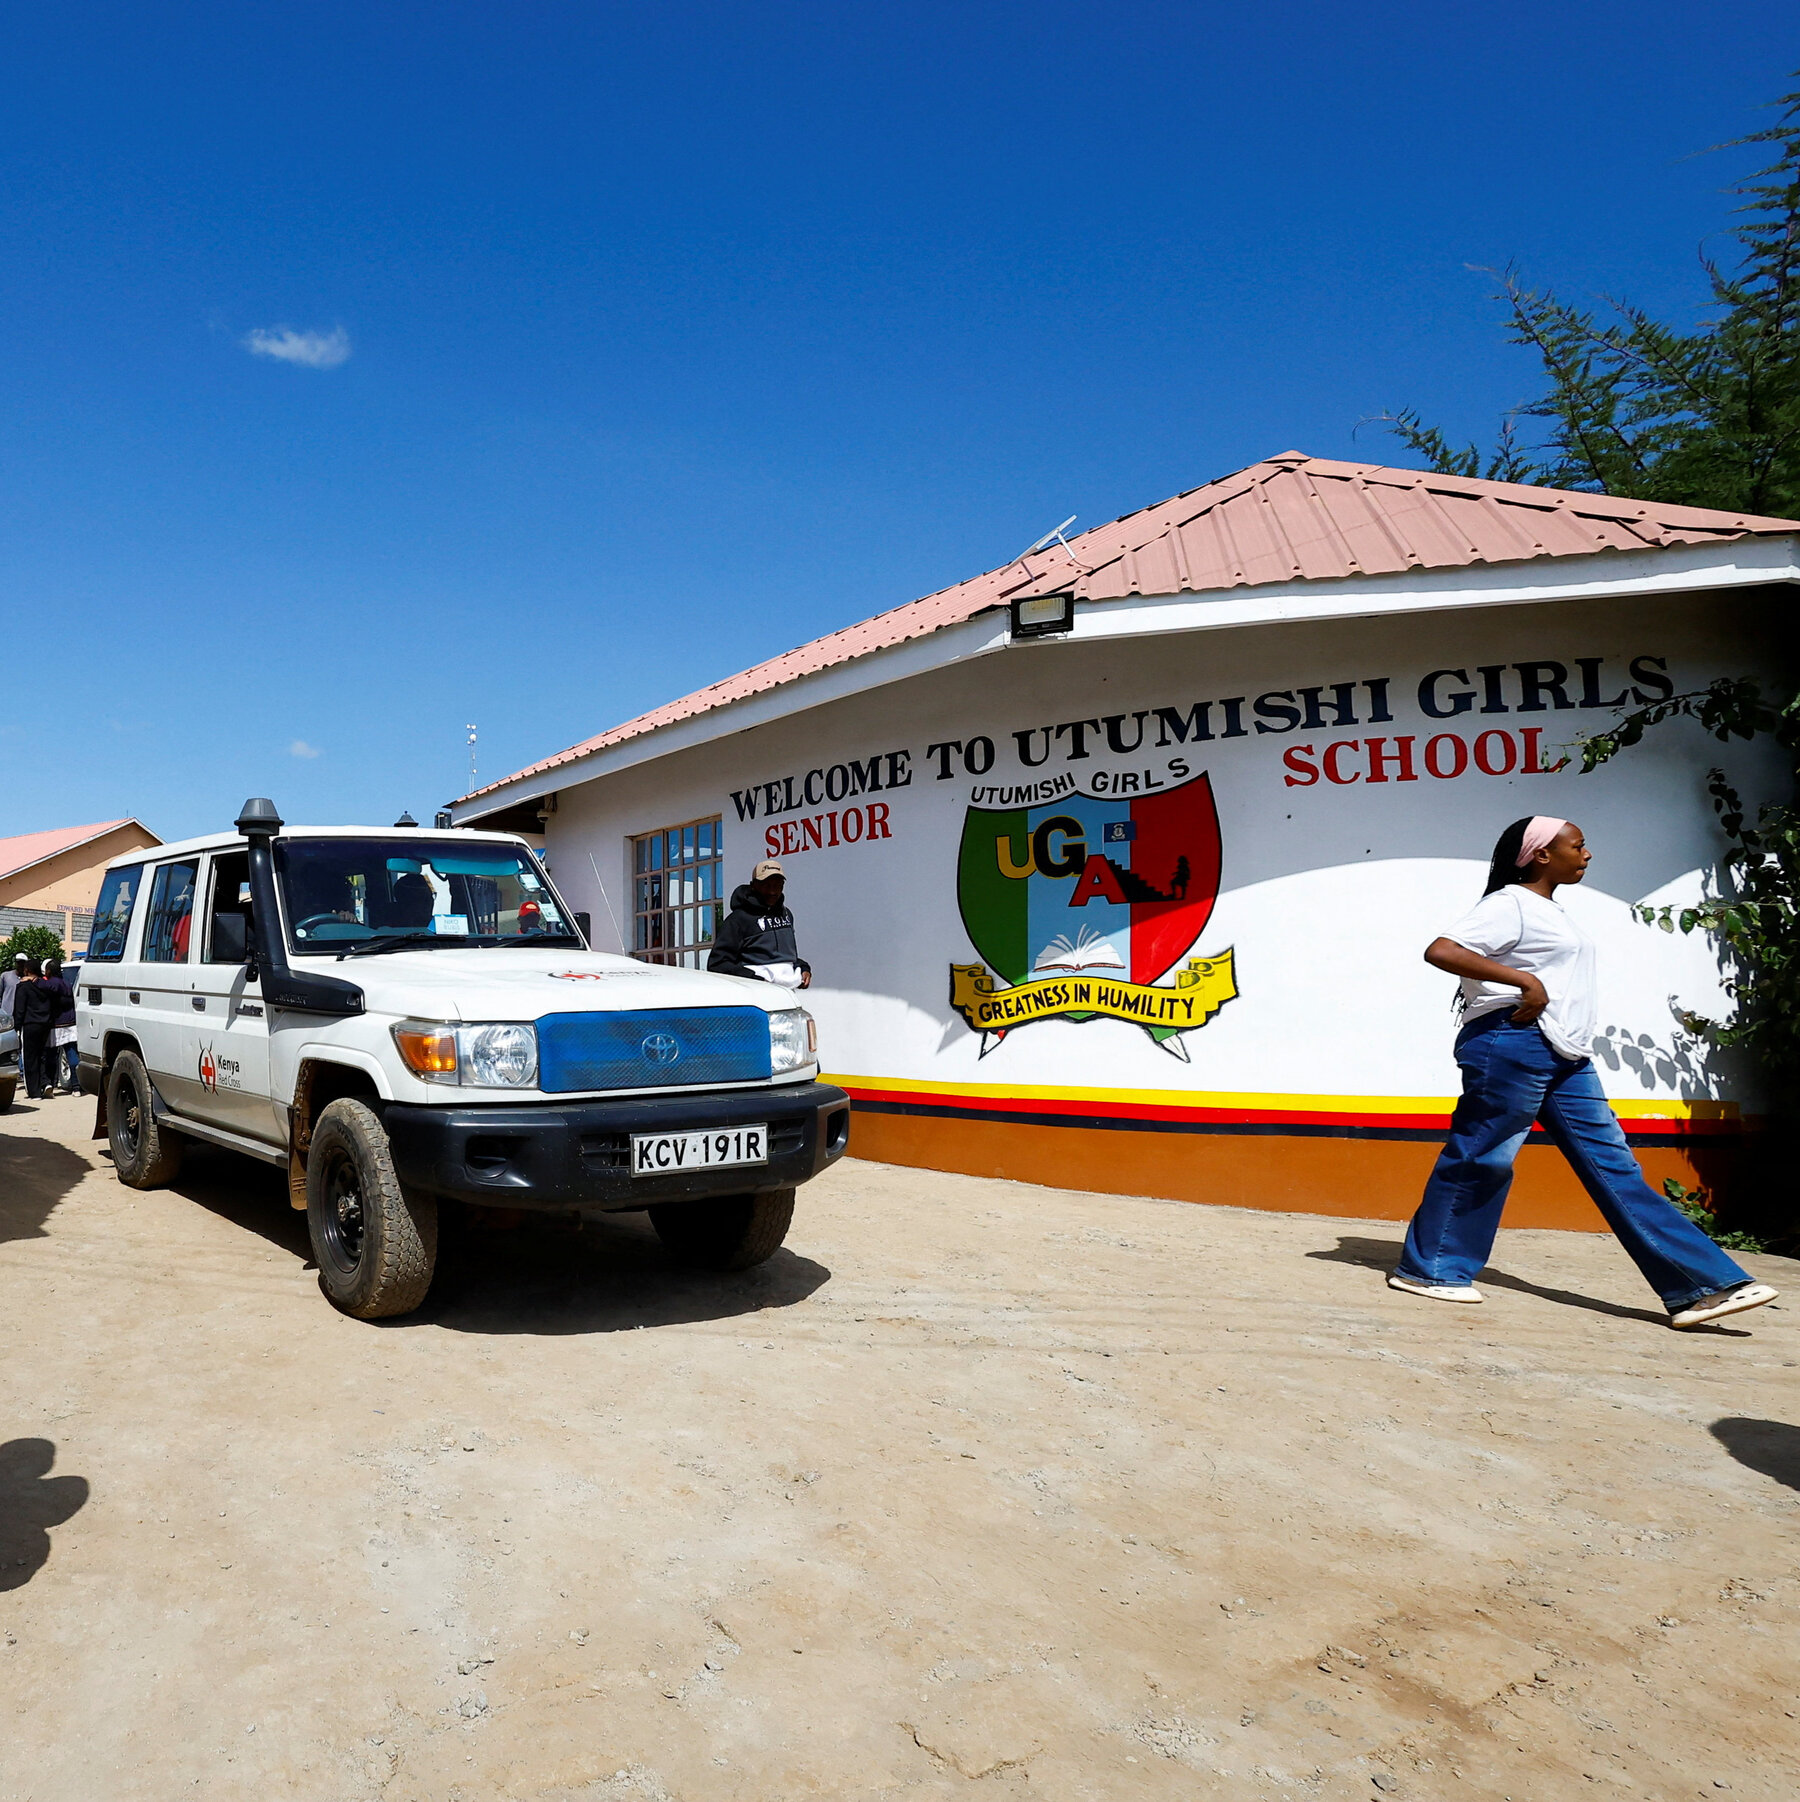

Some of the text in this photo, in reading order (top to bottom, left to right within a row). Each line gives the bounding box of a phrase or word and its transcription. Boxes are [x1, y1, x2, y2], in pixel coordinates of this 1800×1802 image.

[730, 655, 1675, 822] WELCOME TO UTUMISHI GIRLS
[765, 727, 1569, 858] SENIOR SCHOOL
[970, 757, 1190, 804] UTUMISHI GIRLS
[995, 815, 1129, 907] UGA
[56, 904, 84, 914] EDWARD
[978, 983, 1195, 1022] GREATNESS IN HUMILITY
[217, 1054, 240, 1075] Kenya
[218, 1073, 241, 1088] Red Cross
[638, 1132, 761, 1169] KCV 191R
